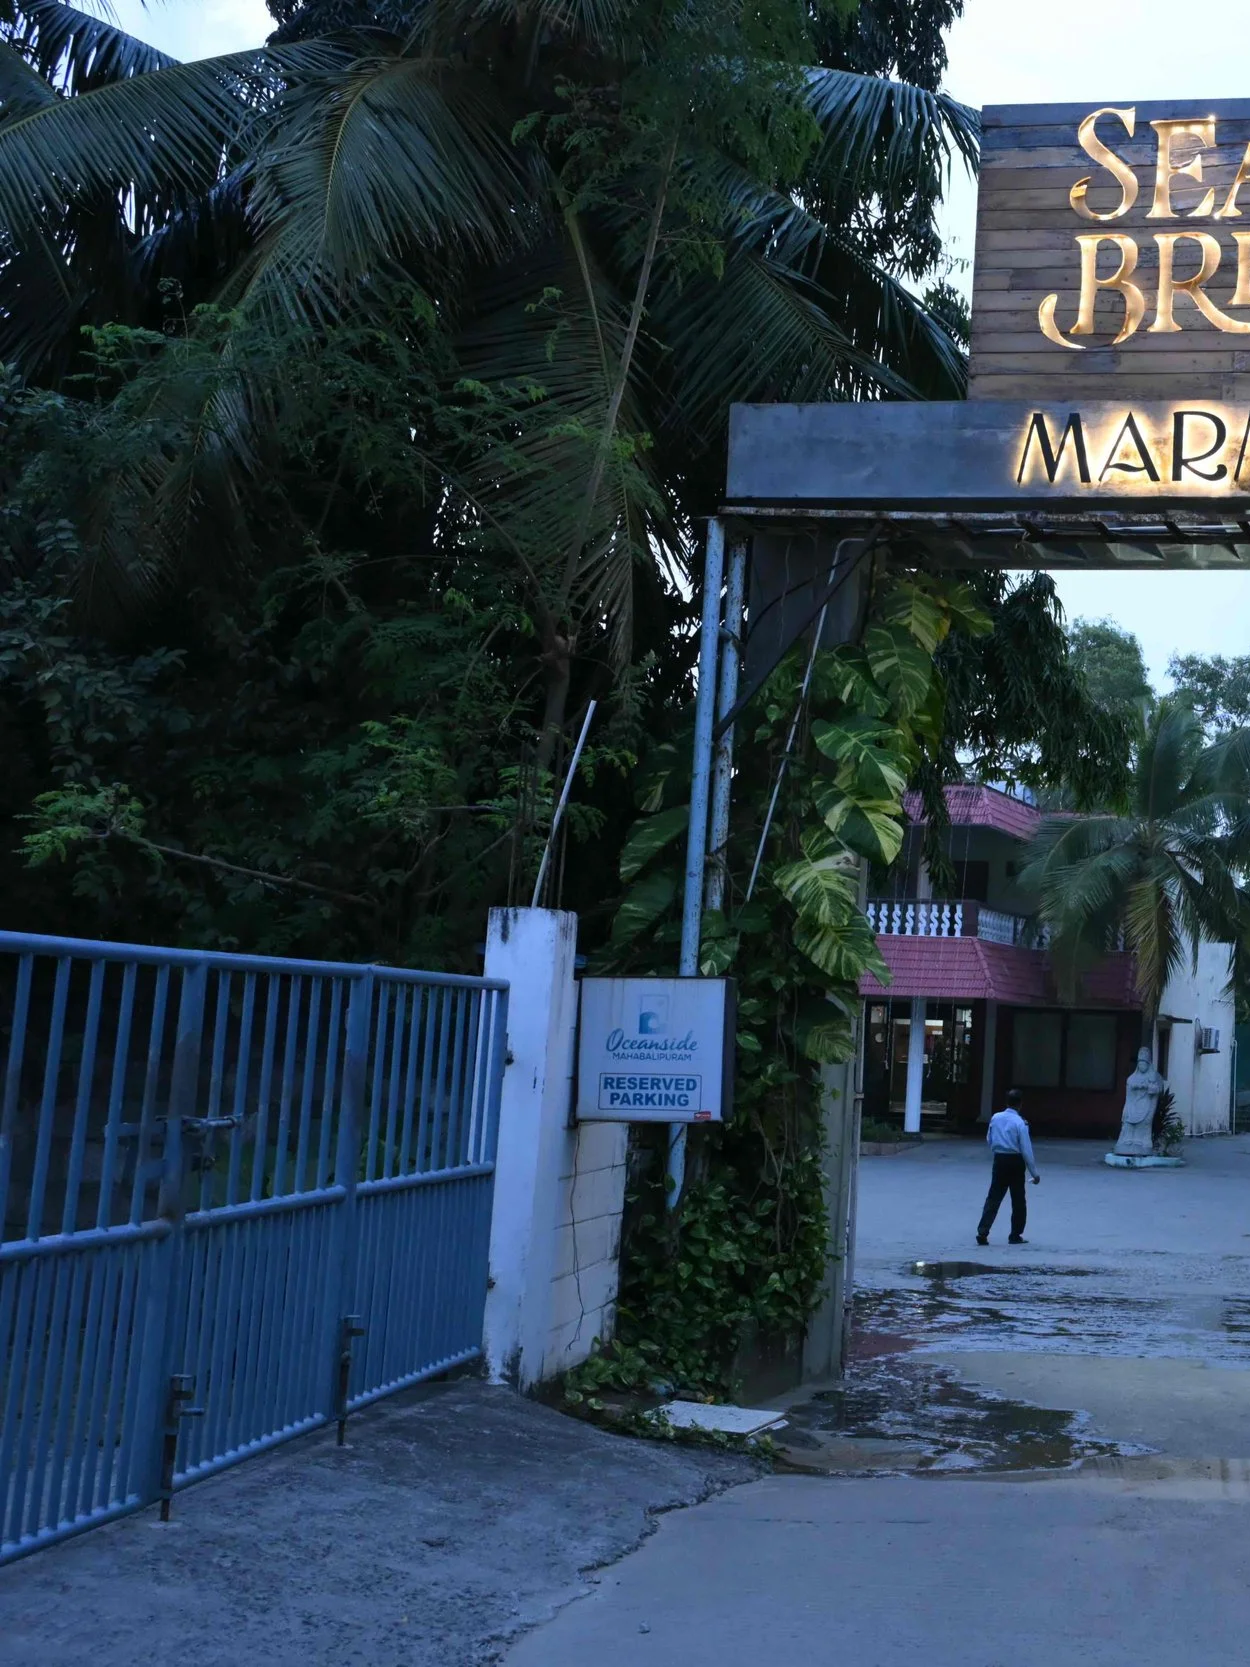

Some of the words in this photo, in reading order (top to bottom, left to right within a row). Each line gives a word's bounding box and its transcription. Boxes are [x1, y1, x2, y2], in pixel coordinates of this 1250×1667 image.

[606, 1028, 698, 1052] Oceanside
[612, 1052, 692, 1061] MAHABALIPURAM
[603, 1076, 697, 1091] RESERVED
[609, 1092, 689, 1106] PARKING
